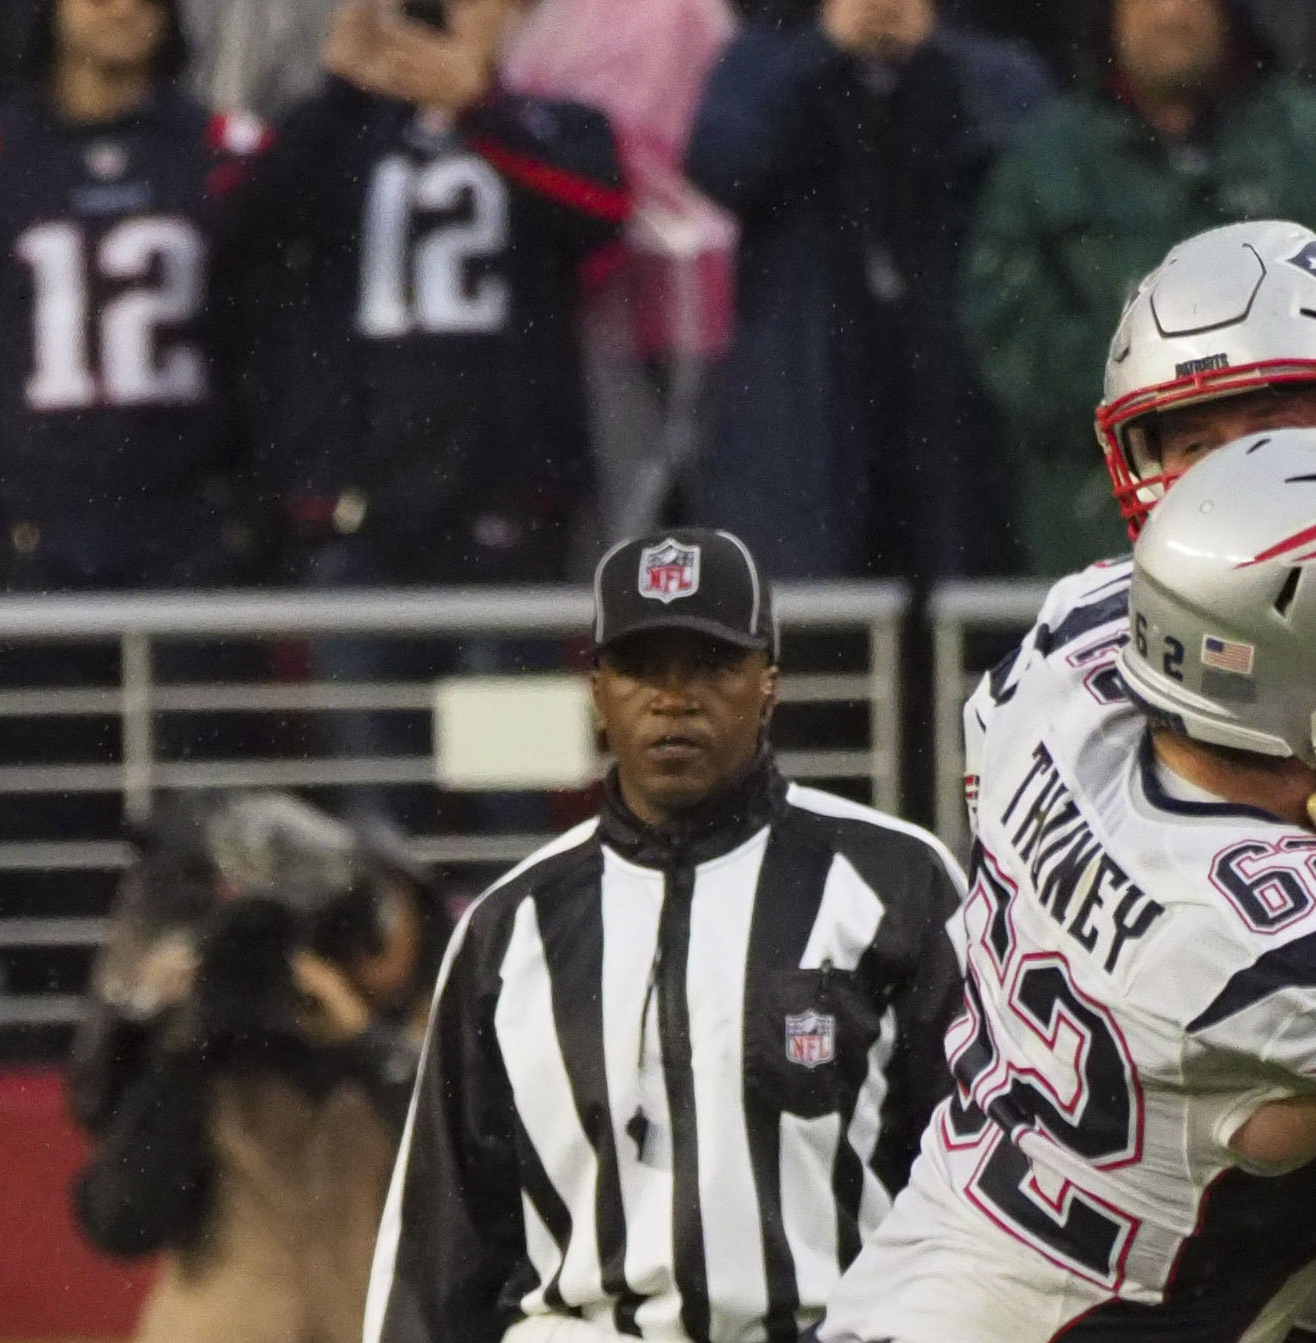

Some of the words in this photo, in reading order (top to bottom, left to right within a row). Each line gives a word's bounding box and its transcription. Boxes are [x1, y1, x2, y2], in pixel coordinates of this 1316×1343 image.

[15, 213, 213, 408] 12
[357, 153, 511, 337] 12
[790, 1034, 832, 1062] NFL
